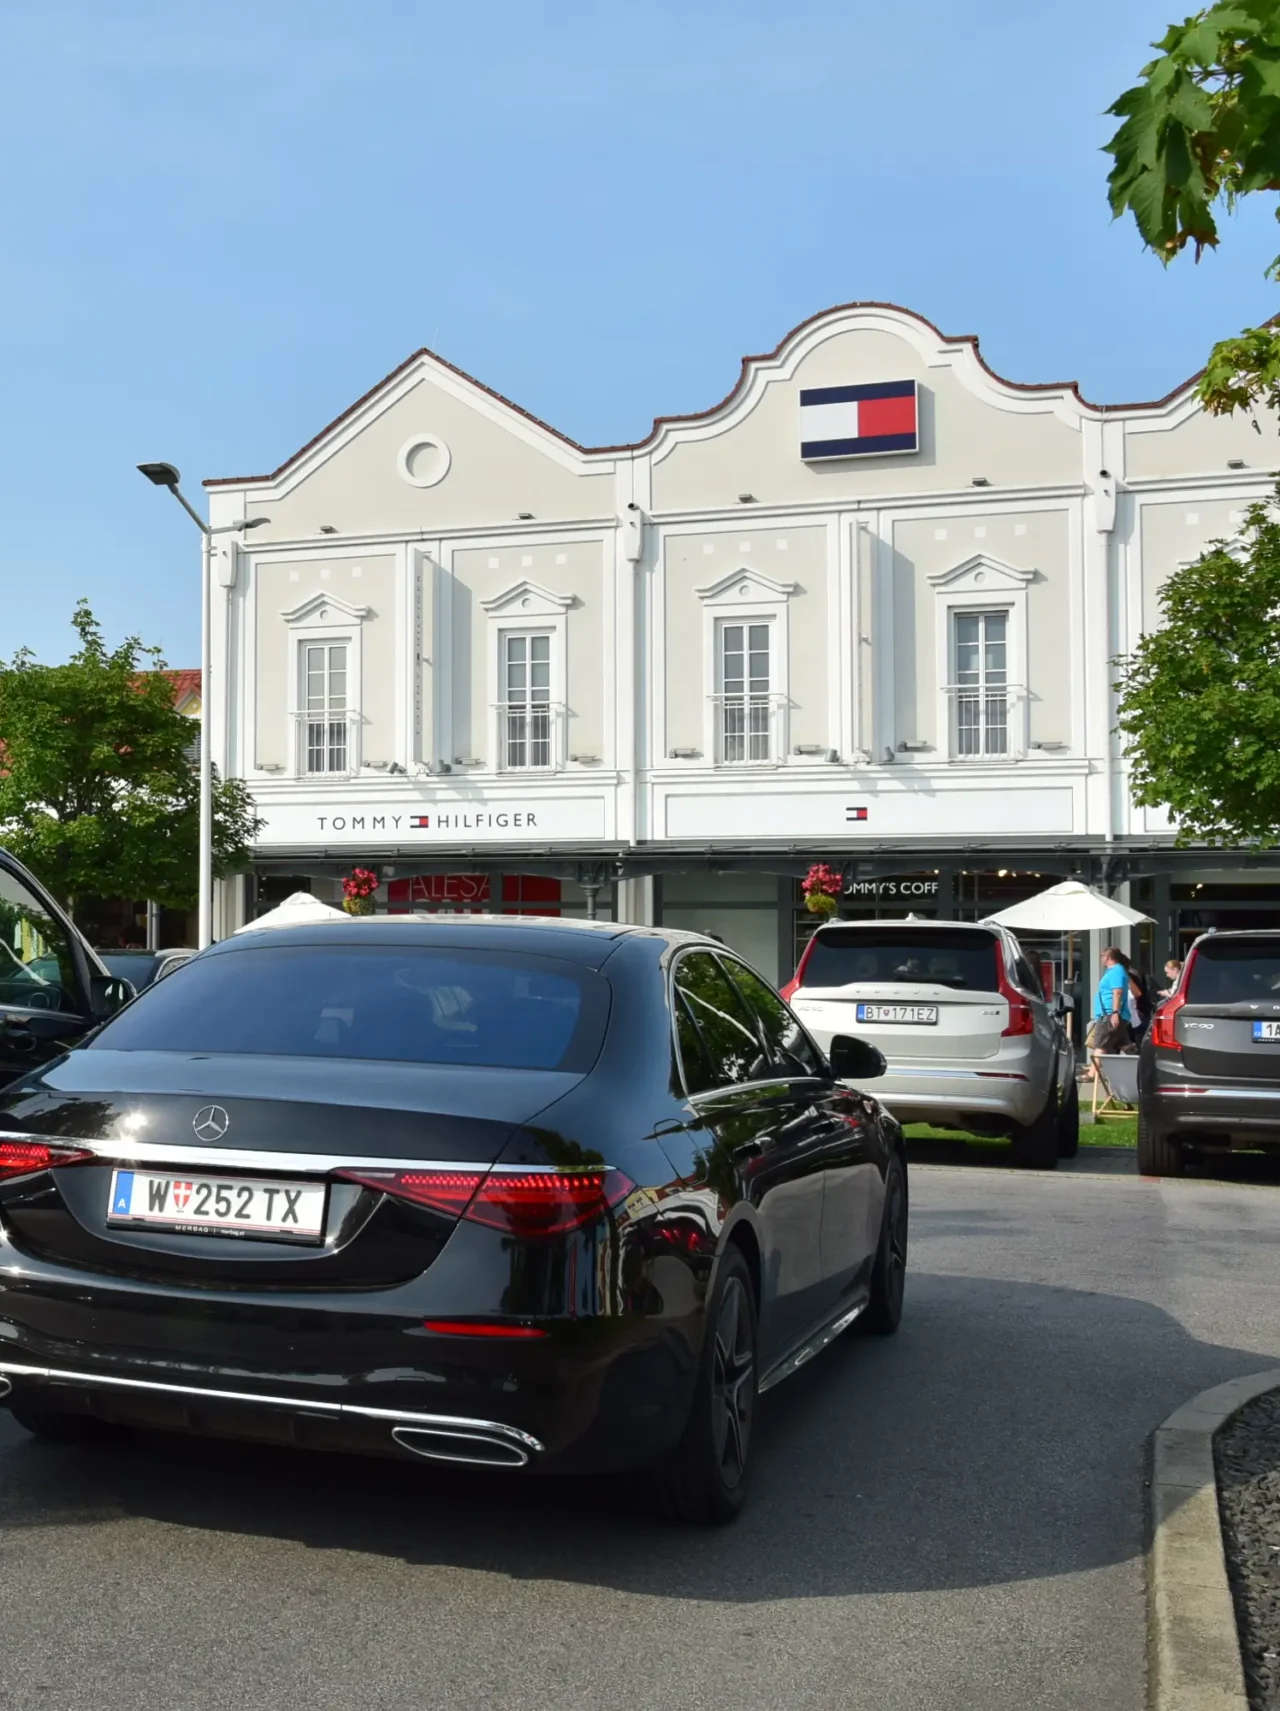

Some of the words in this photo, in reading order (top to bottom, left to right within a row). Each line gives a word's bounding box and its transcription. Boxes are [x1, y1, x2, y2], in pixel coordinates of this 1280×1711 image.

[317, 815, 402, 830] TOMMY
[437, 813, 538, 828] HILFIGER
[866, 1006, 883, 1019] BT
[892, 1007, 935, 1021] 171EZ
[117, 1198, 127, 1209] A
[148, 1179, 170, 1213] W
[193, 1182, 254, 1219] 252
[263, 1188, 302, 1224] TX
[174, 1224, 209, 1233] MERBAG
